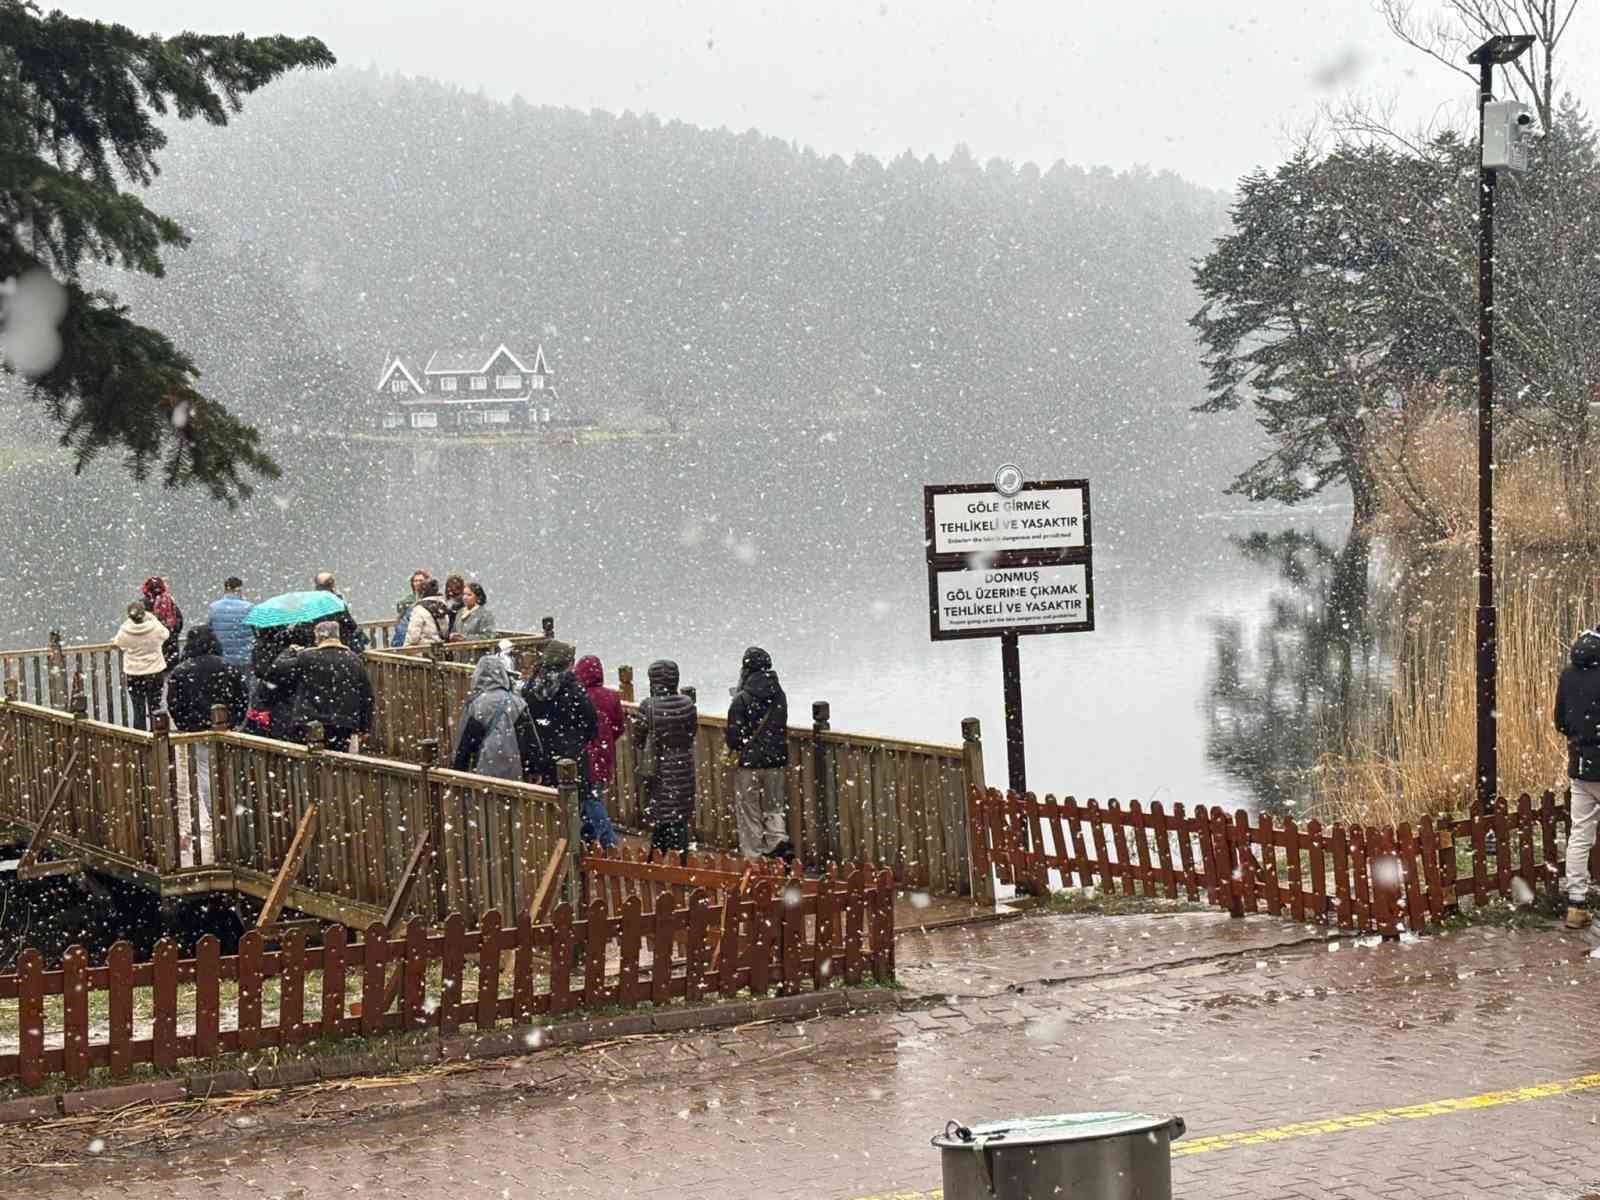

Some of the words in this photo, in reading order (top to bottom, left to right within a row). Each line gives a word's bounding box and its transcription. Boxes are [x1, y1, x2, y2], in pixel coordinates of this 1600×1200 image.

[967, 500, 999, 513] GÖLE
[1003, 499, 1050, 512] GİRMEK
[940, 518, 999, 533] TEHLİKELİ
[1003, 519, 1018, 529] VE
[1021, 517, 1078, 529] YASAKTIR
[985, 571, 1040, 583] DONMUŞ
[946, 588, 972, 601] GÖL
[1030, 584, 1078, 599] ÇIKMAK
[944, 601, 1002, 616] TEHLİKELİ
[1006, 602, 1021, 613] VE
[1026, 600, 1081, 612] YASAKTIR
